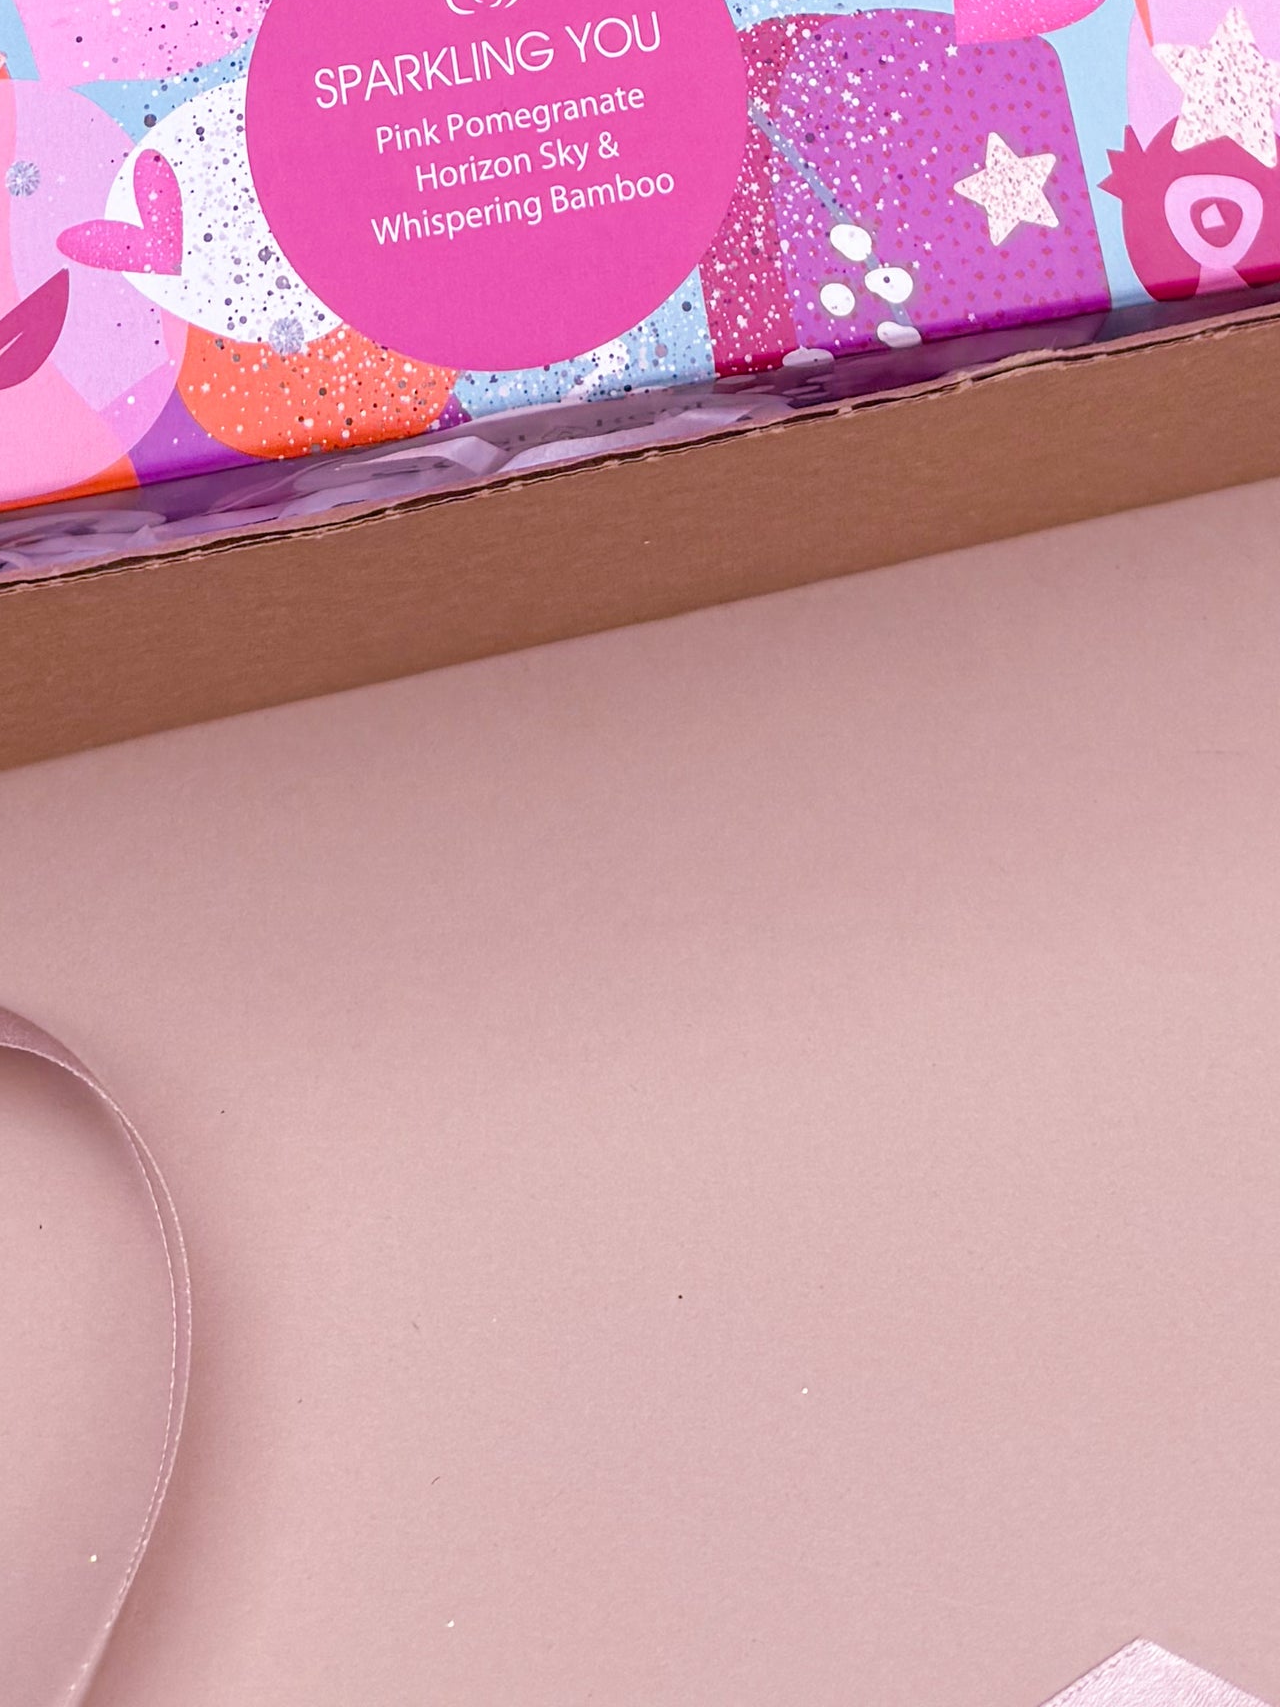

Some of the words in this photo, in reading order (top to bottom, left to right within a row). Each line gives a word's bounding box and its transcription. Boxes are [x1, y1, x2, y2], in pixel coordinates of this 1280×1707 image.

[313, 30, 555, 109] SPARKLING
[564, 10, 662, 64] YOU
[375, 115, 441, 155] Pink
[447, 86, 646, 143] Pomegranate
[414, 147, 532, 192] Horizon
[538, 136, 589, 171] Sky
[597, 131, 620, 159] &
[370, 192, 544, 245] Whispering
[550, 171, 676, 214] Bamboo
